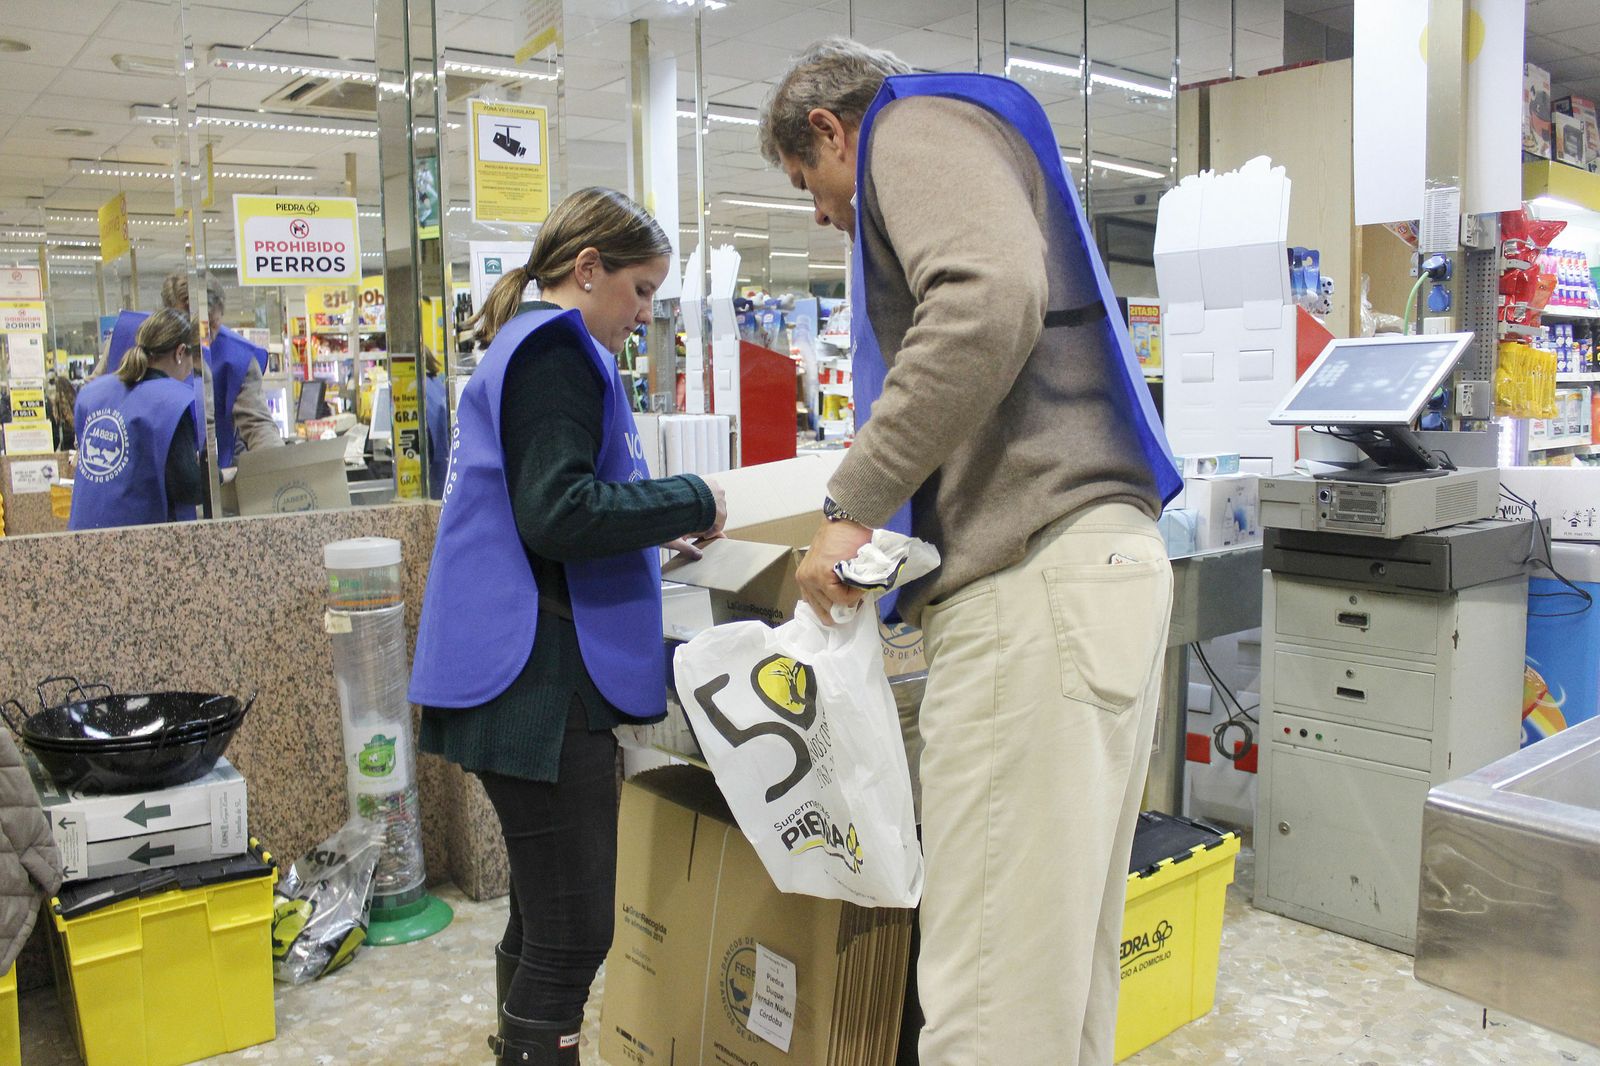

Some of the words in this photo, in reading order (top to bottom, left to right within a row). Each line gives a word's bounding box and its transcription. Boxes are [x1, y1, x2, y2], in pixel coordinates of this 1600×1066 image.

[254, 240, 346, 253] PROHIBIDO
[255, 256, 346, 273] PERROS
[1504, 505, 1524, 515] MUY
[898, 651, 910, 660] DE
[1132, 966, 1138, 975] A
[1138, 950, 1172, 971] DOMICILIO
[766, 972, 785, 989] Piedra
[766, 985, 784, 1001] Duque
[755, 992, 774, 1009] Fernán
[774, 1003, 792, 1019] Núñez
[759, 1009, 783, 1028] Córdoba
